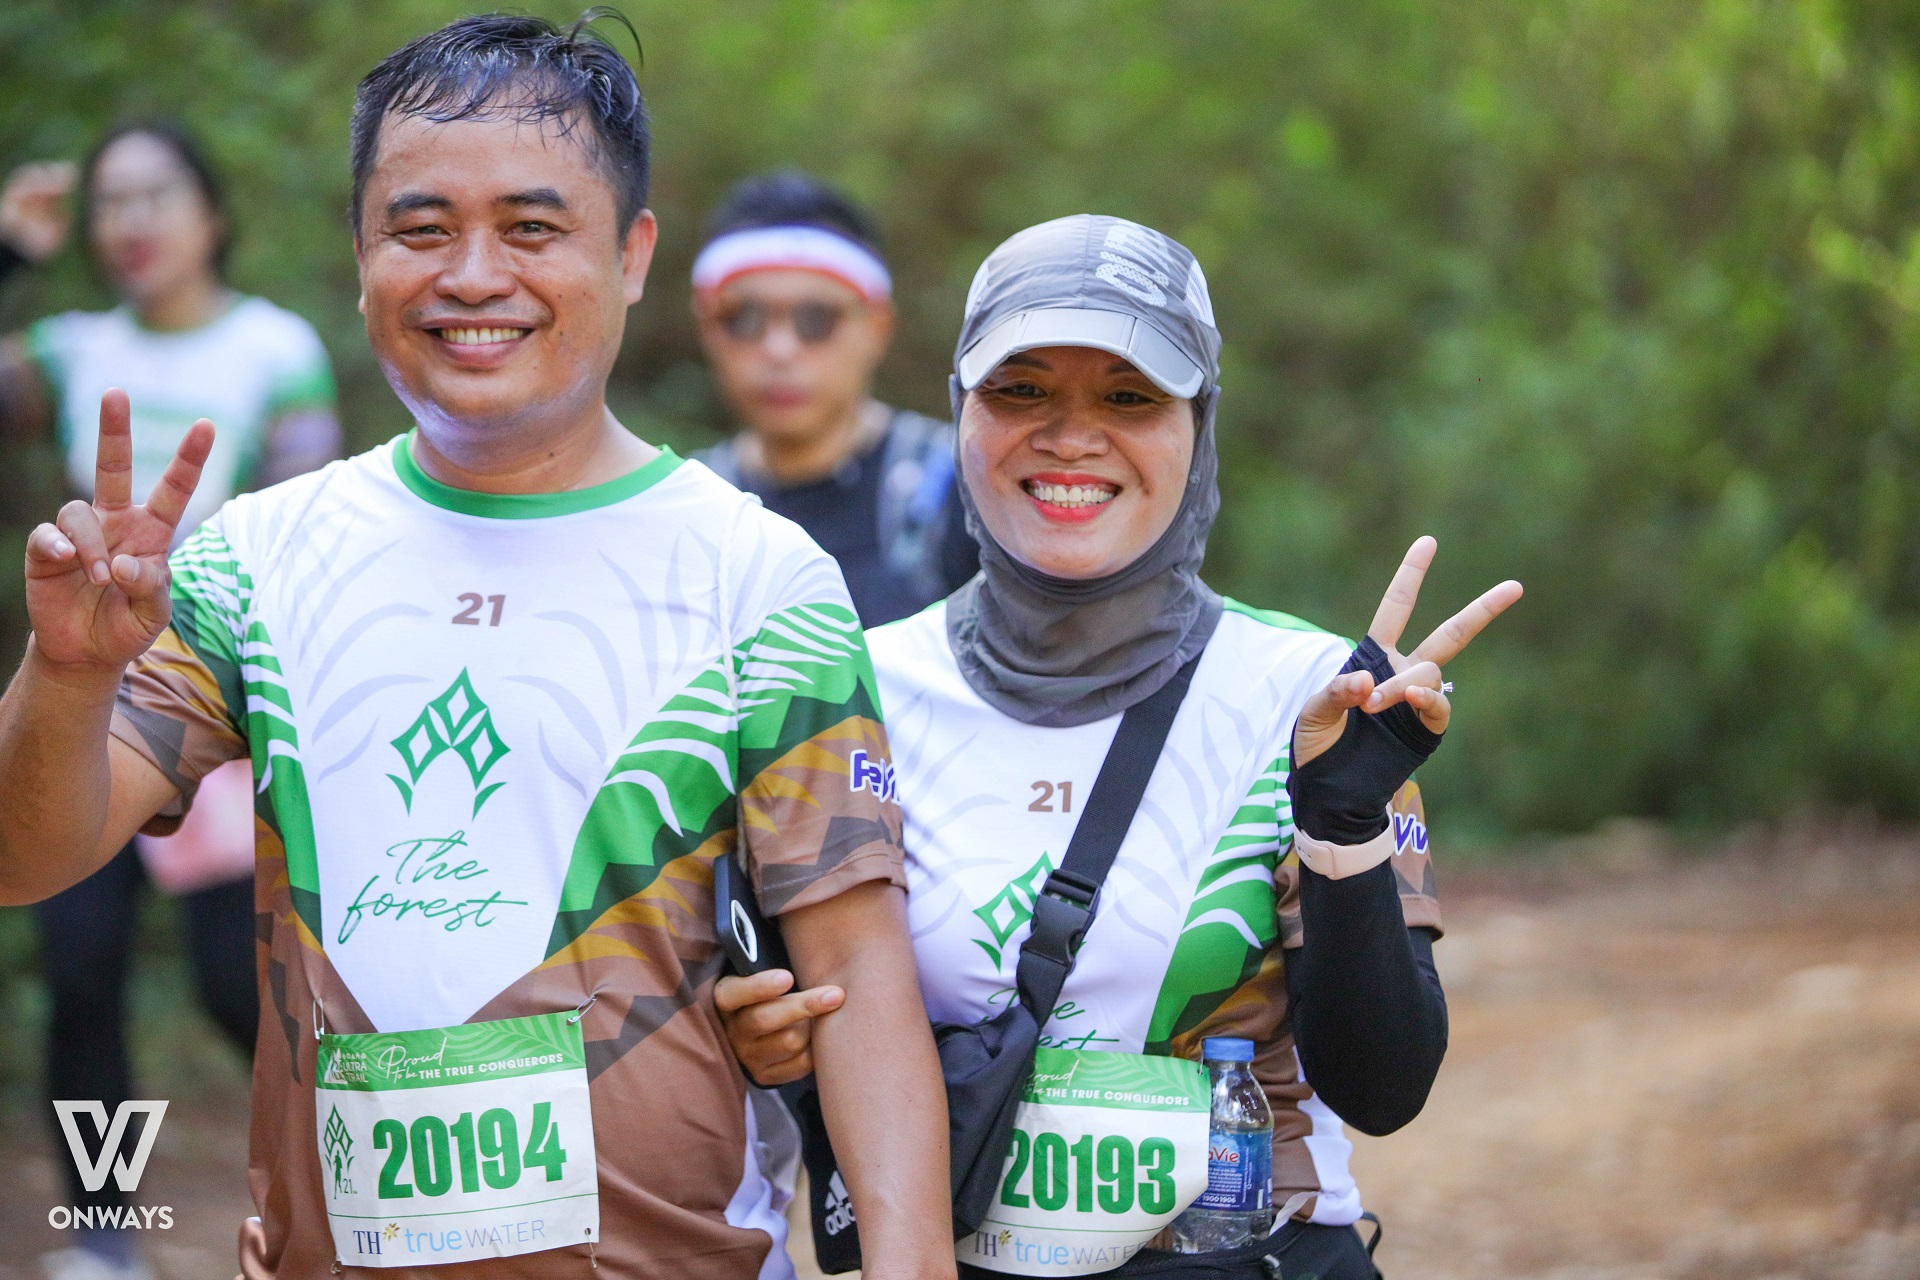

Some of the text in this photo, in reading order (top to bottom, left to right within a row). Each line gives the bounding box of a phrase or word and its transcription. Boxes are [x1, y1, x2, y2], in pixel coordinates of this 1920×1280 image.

[452, 592, 506, 627] 21
[1028, 780, 1073, 813] 21
[386, 830, 489, 884] The
[338, 875, 529, 944] forest
[378, 1037, 448, 1079] Proud
[419, 1069, 441, 1080] THE
[445, 1065, 474, 1077] TRUE
[478, 1053, 564, 1073] CONQUERORS
[1028, 1059, 1080, 1086] roud
[1046, 1087, 1067, 1098] THE
[1072, 1089, 1100, 1099] TRUE
[1104, 1090, 1190, 1106] CONQUERORS
[372, 1101, 567, 1200] 20194
[1208, 1146, 1239, 1163] aVie
[1001, 1128, 1176, 1215] 20193
[353, 1229, 383, 1255] TH
